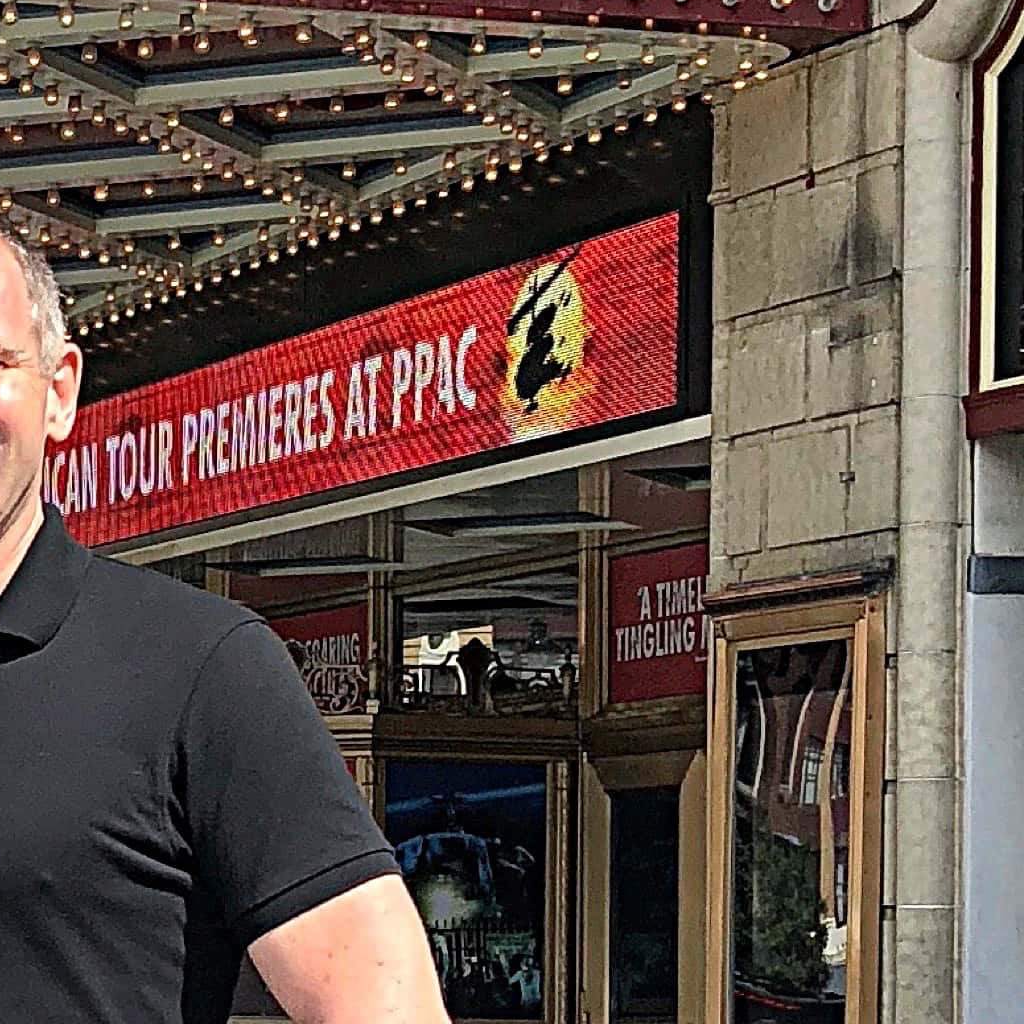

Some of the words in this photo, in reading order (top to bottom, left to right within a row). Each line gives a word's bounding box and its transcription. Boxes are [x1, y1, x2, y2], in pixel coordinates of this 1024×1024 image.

[105, 419, 174, 505] TOUR
[181, 369, 337, 486] PREMIERES
[343, 355, 383, 441] AT
[391, 323, 478, 430] PPAC
[615, 616, 696, 662] TINGLING
